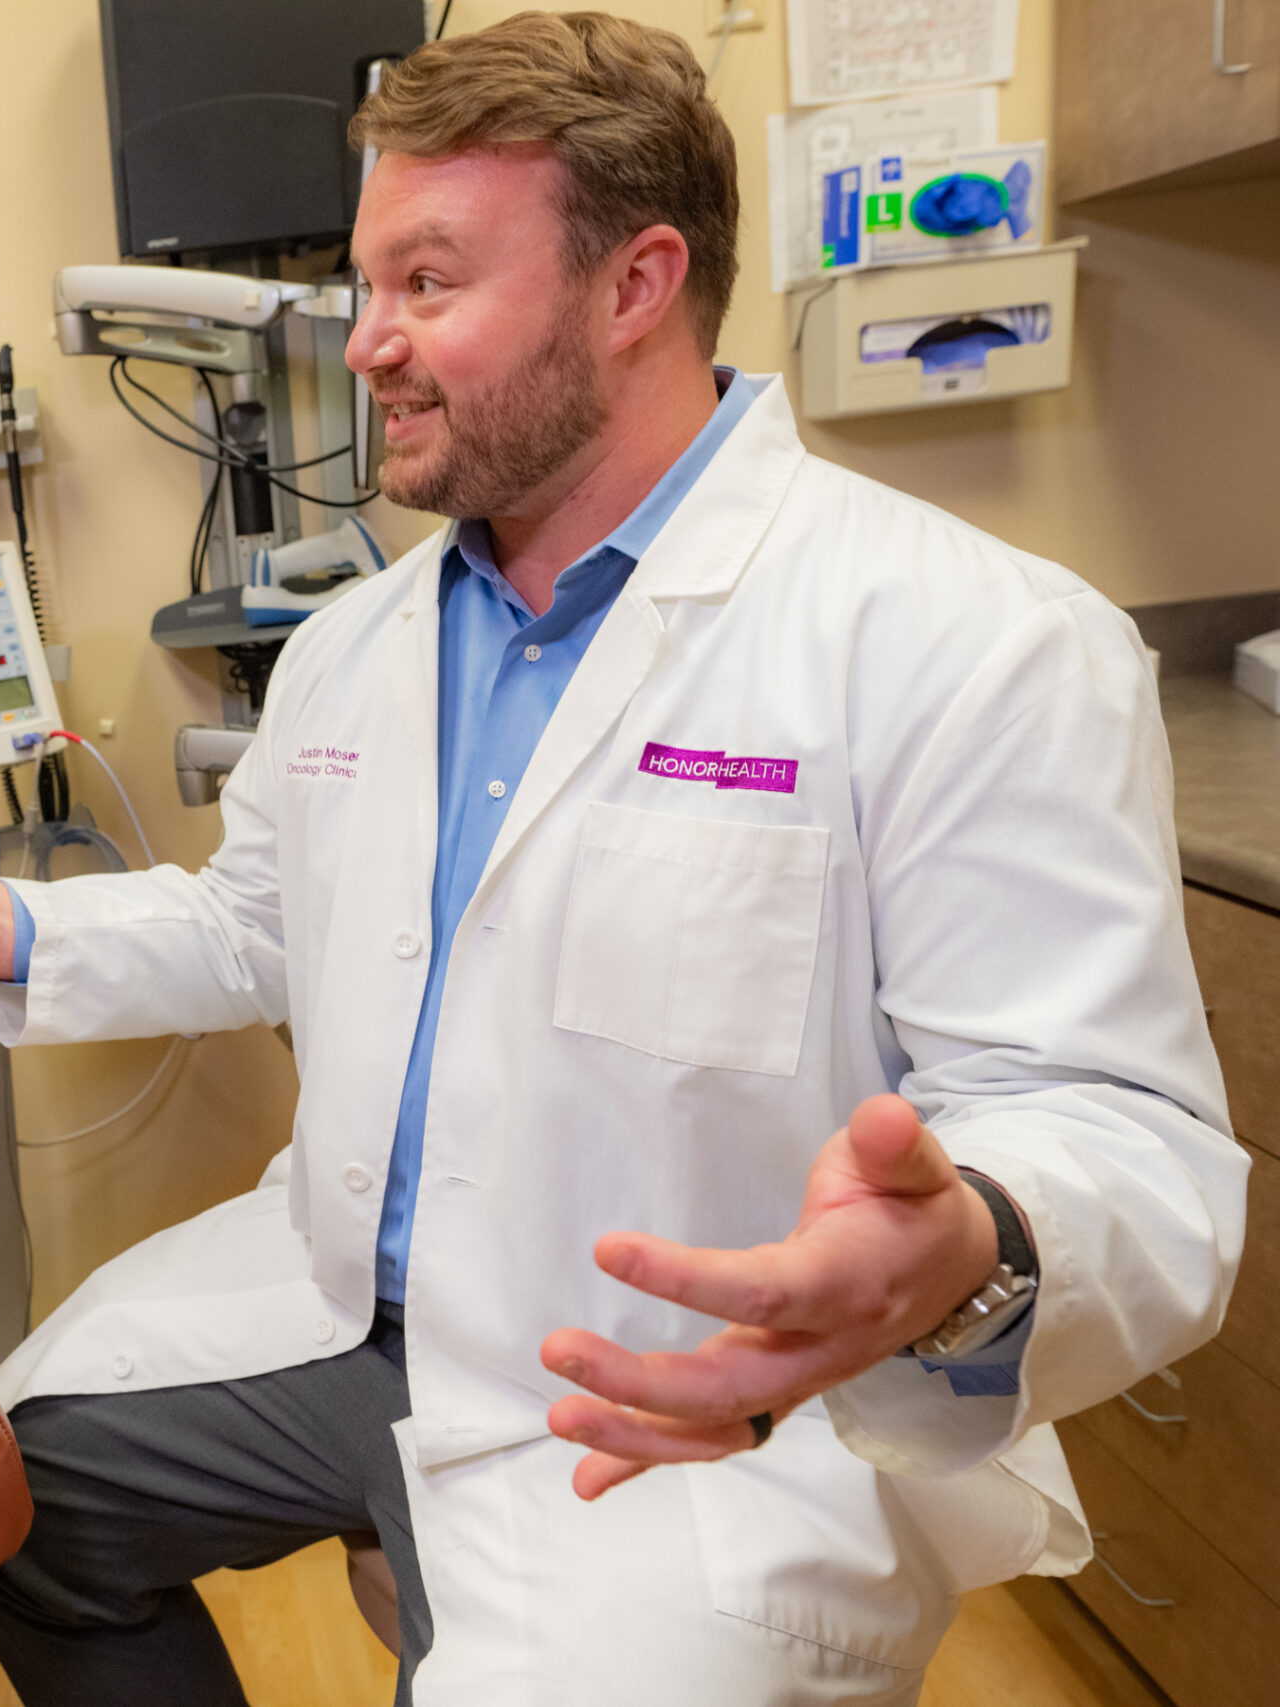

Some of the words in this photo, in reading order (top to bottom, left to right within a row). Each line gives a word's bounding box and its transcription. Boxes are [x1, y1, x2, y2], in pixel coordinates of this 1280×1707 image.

[878, 194, 894, 221] L
[298, 746, 323, 759] Justin
[324, 747, 360, 762] Moser
[286, 762, 322, 777] Oncology
[649, 754, 787, 780] HONORHEALTH
